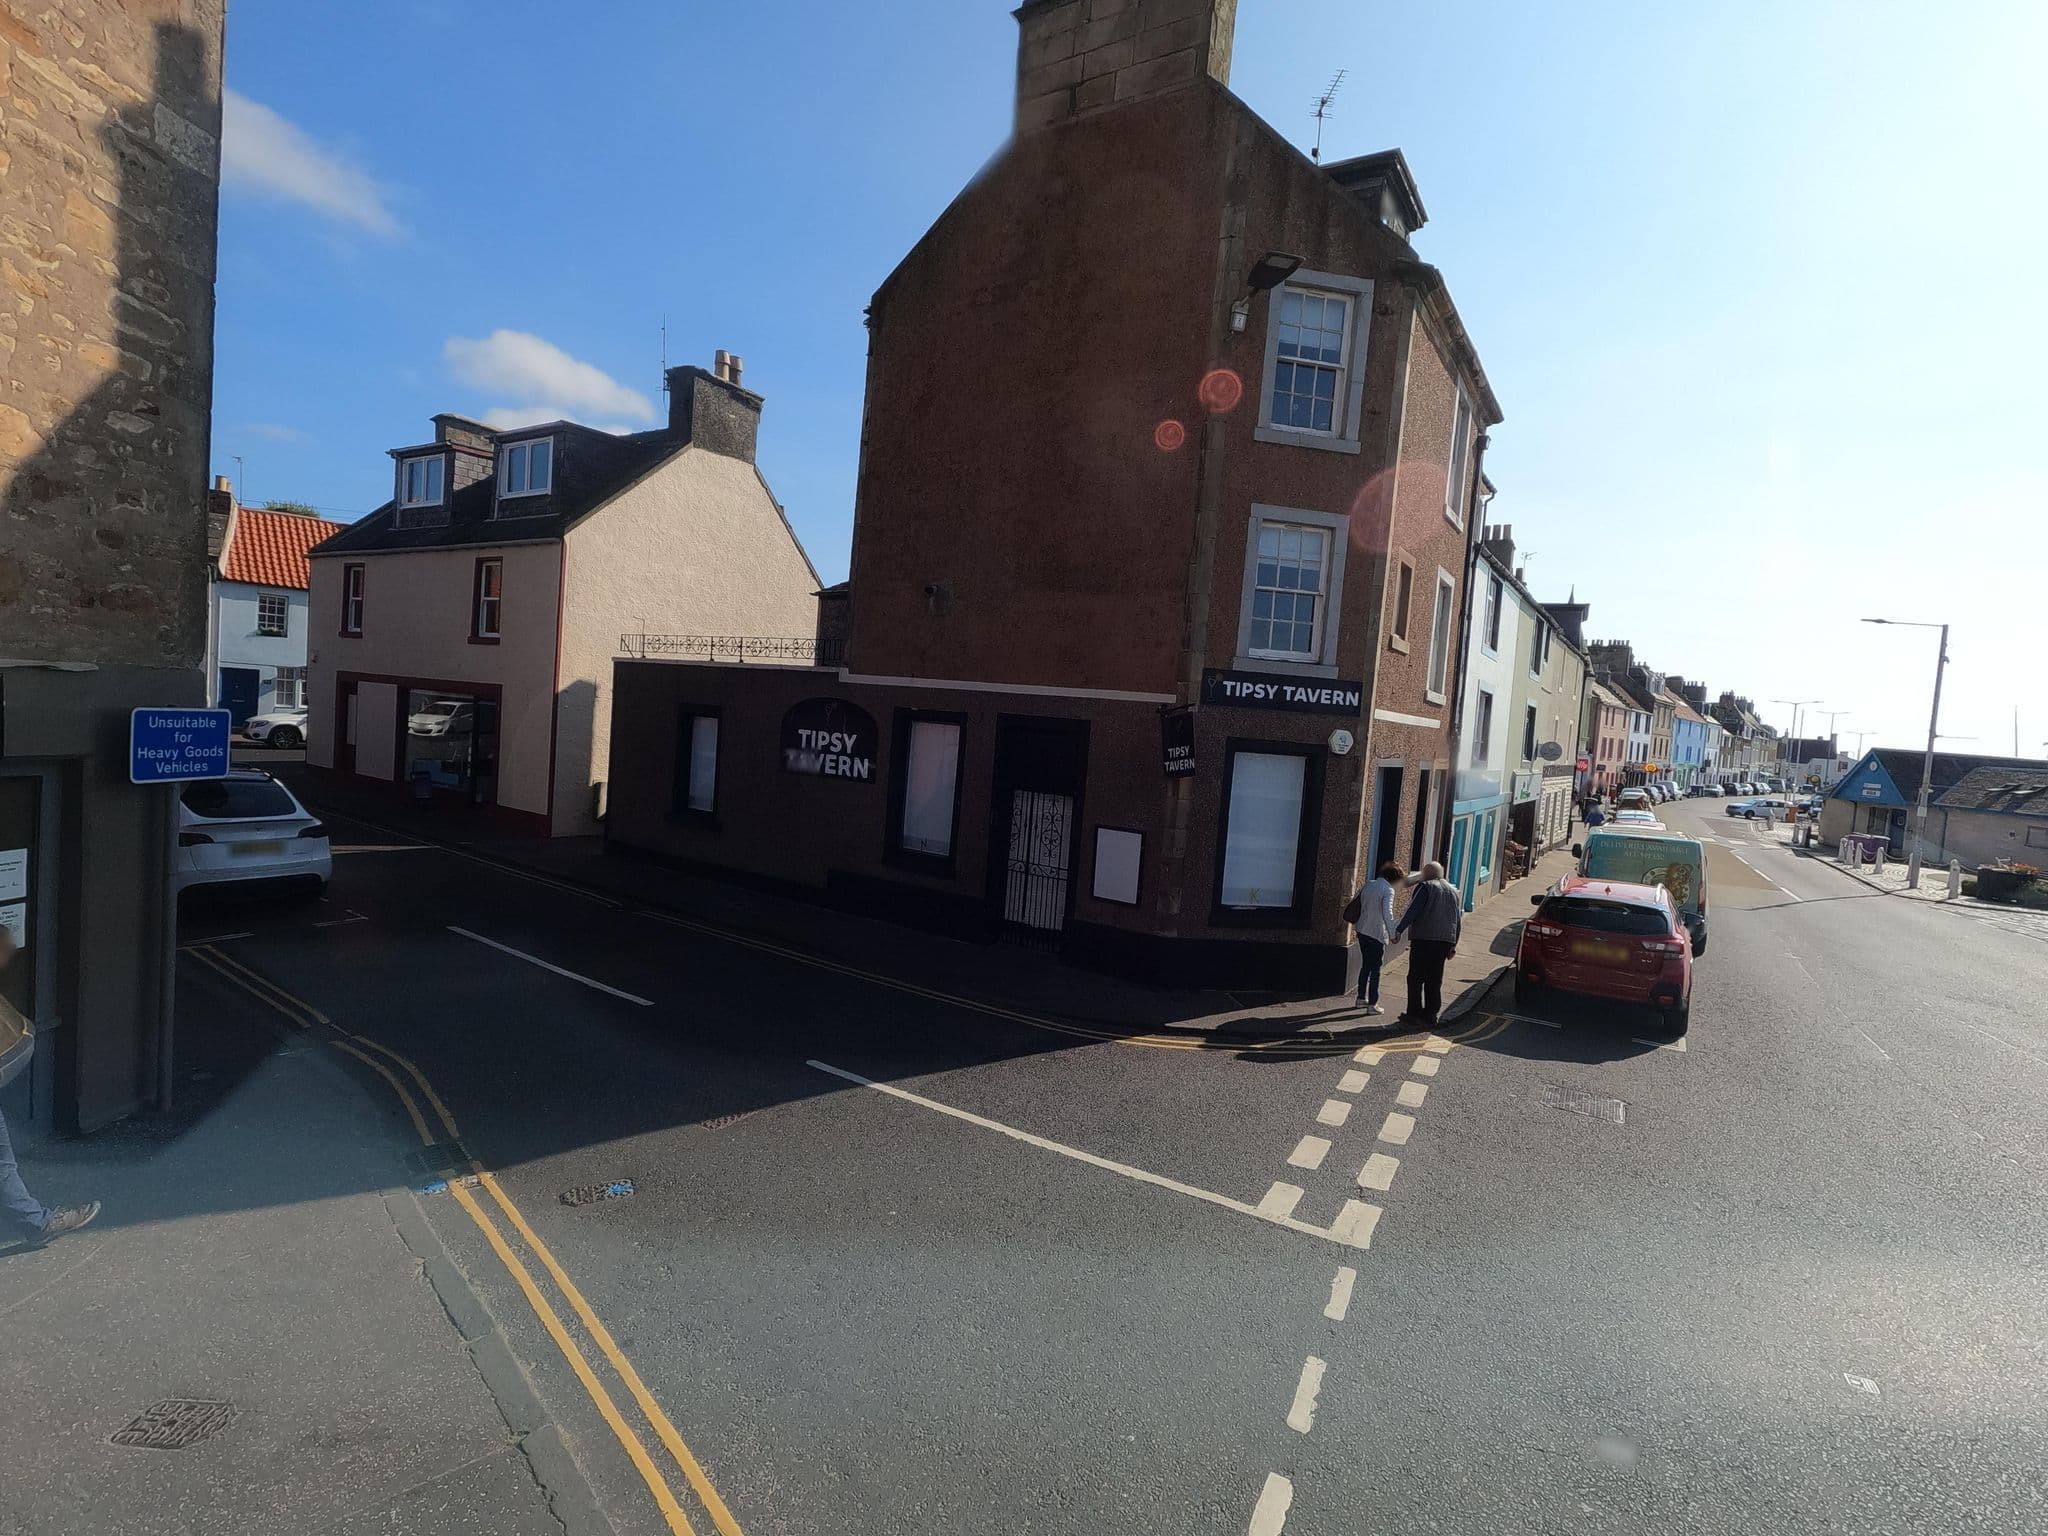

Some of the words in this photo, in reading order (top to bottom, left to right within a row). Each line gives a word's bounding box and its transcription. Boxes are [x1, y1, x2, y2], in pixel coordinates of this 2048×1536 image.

[1222, 680, 1279, 700] TIPSY
[1282, 685, 1360, 706] TAVERN
[148, 716, 217, 728] Unsuitable
[174, 731, 193, 743] for
[798, 729, 858, 754] TIPSY
[137, 746, 179, 760] Heavy
[184, 746, 224, 758] Goods
[1167, 745, 1190, 758] TIPSY
[156, 761, 208, 774] Vehicles
[1164, 758, 1195, 772] TAVERN
